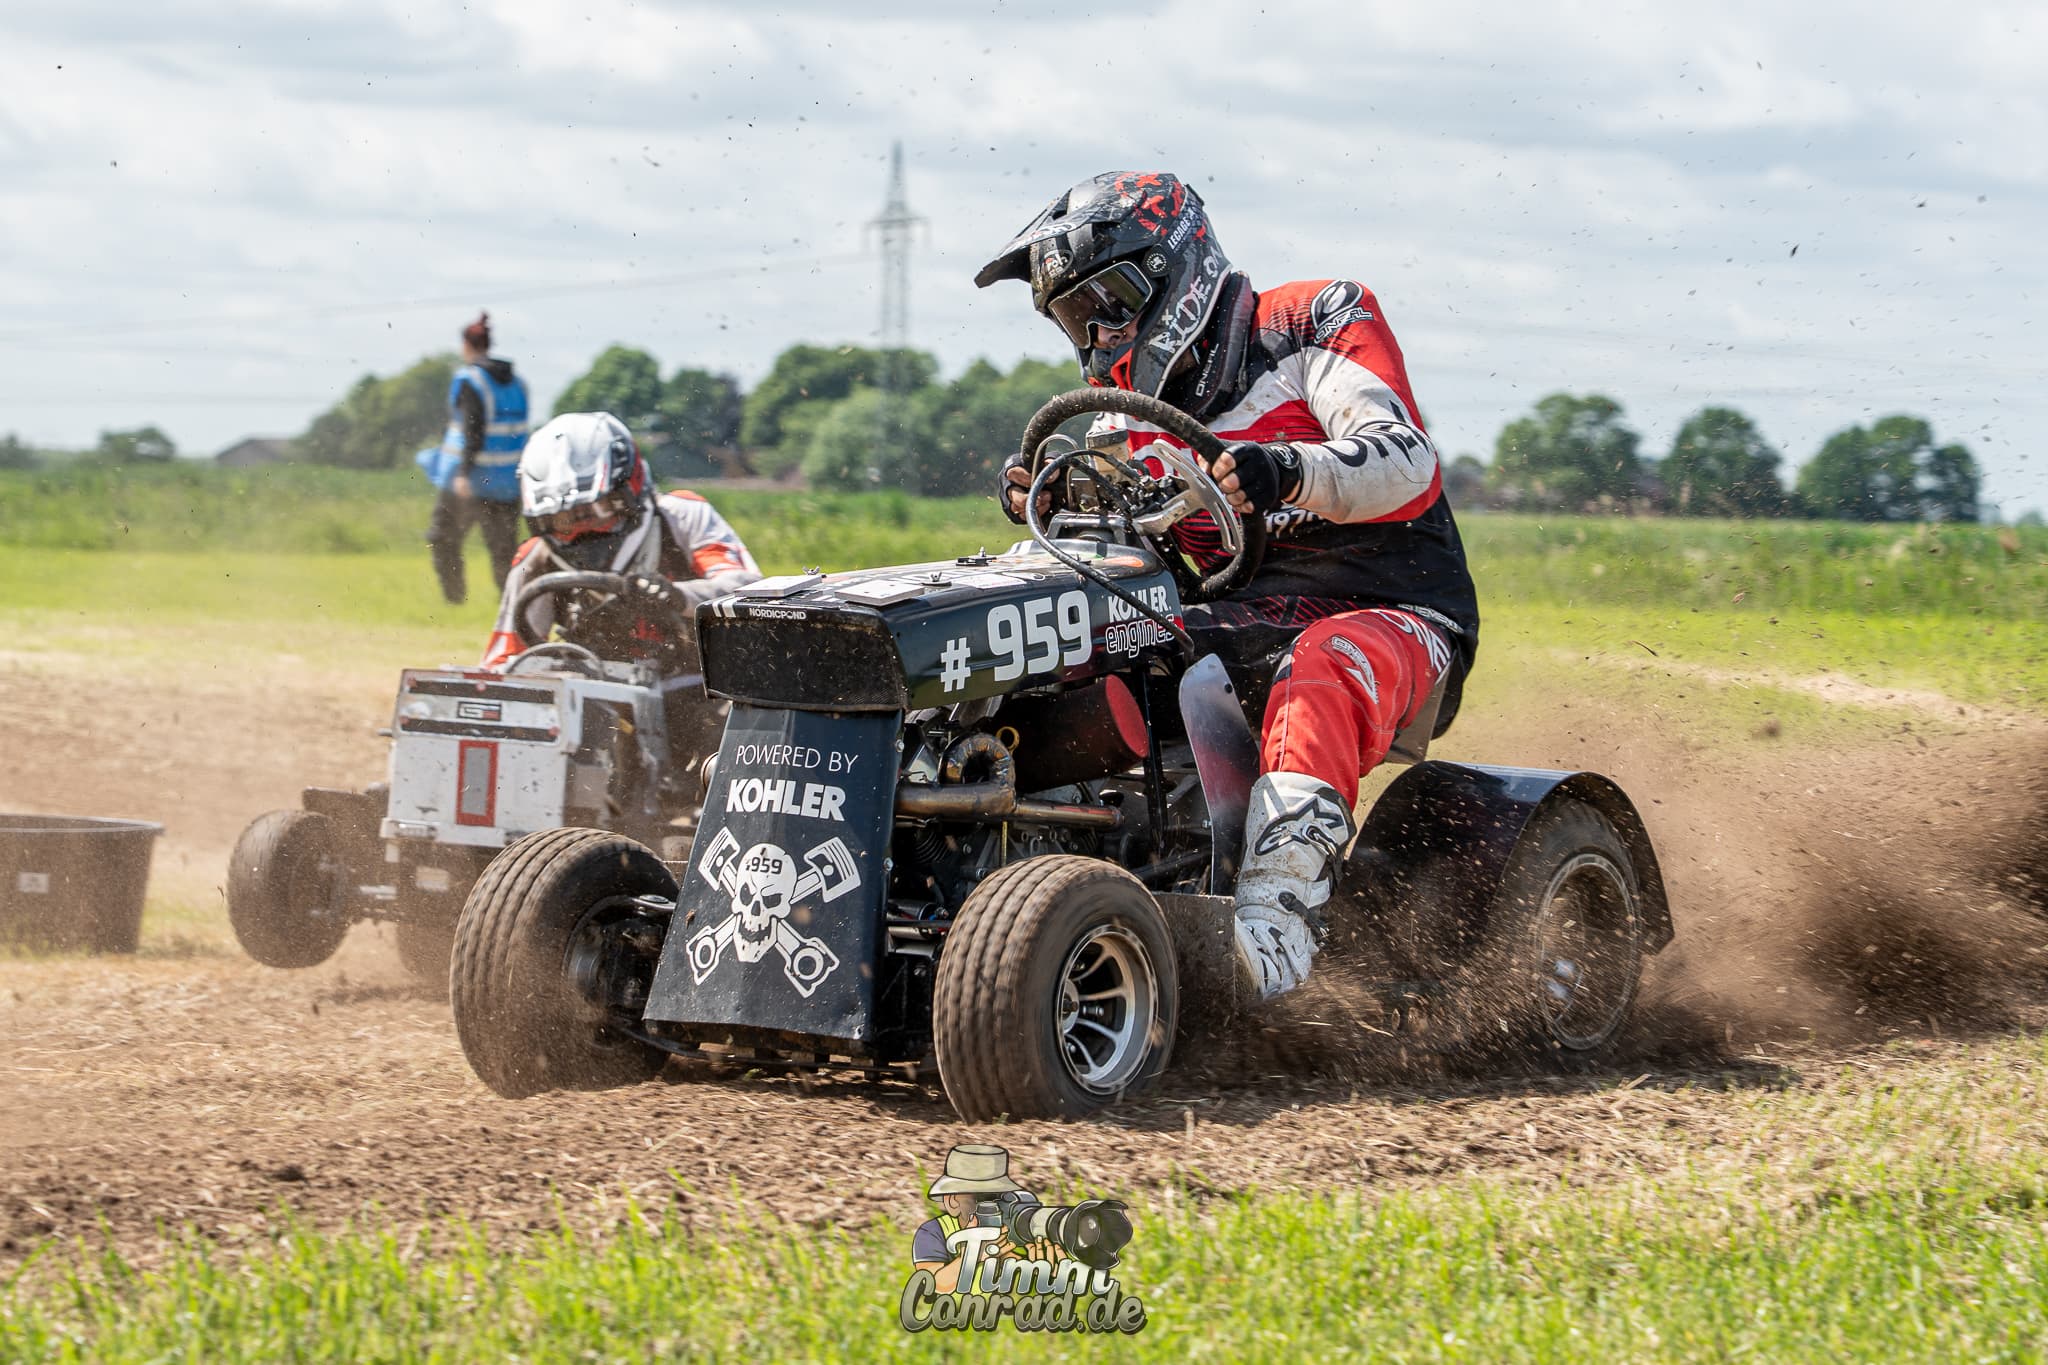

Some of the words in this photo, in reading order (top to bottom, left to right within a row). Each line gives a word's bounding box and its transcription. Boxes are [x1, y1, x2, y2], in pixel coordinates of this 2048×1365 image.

[749, 607, 807, 620] NORDICPOND
[987, 590, 1093, 682] 959
[735, 744, 822, 769] POWERED
[828, 751, 859, 774] BY
[726, 778, 846, 822] KOHLER
